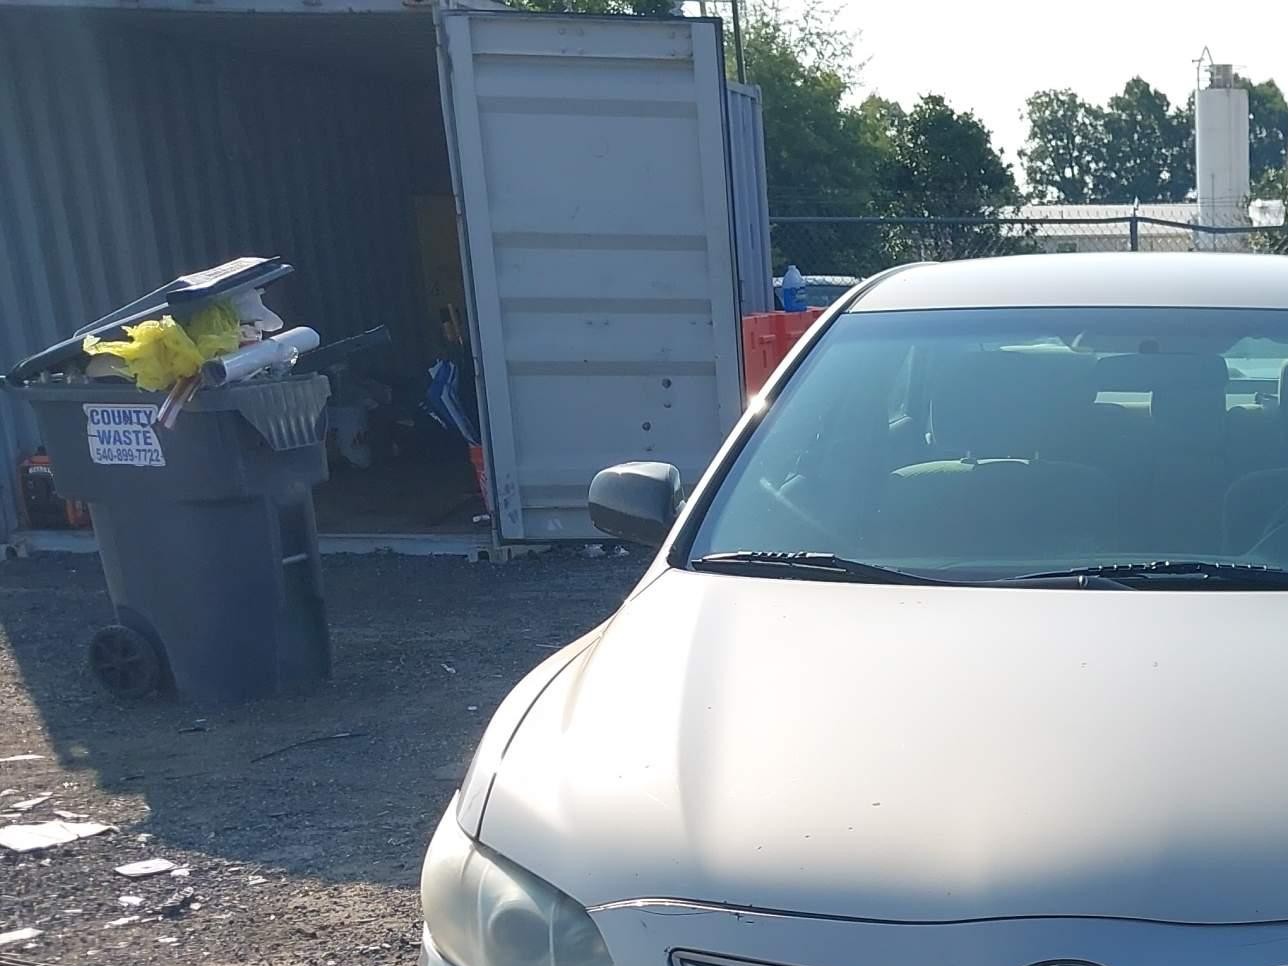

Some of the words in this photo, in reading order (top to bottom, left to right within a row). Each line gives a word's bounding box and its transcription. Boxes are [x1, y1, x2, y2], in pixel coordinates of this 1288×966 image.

[89, 408, 153, 426] COUNTY
[96, 429, 153, 446] WASTE
[95, 447, 161, 464] 540-899-7722
